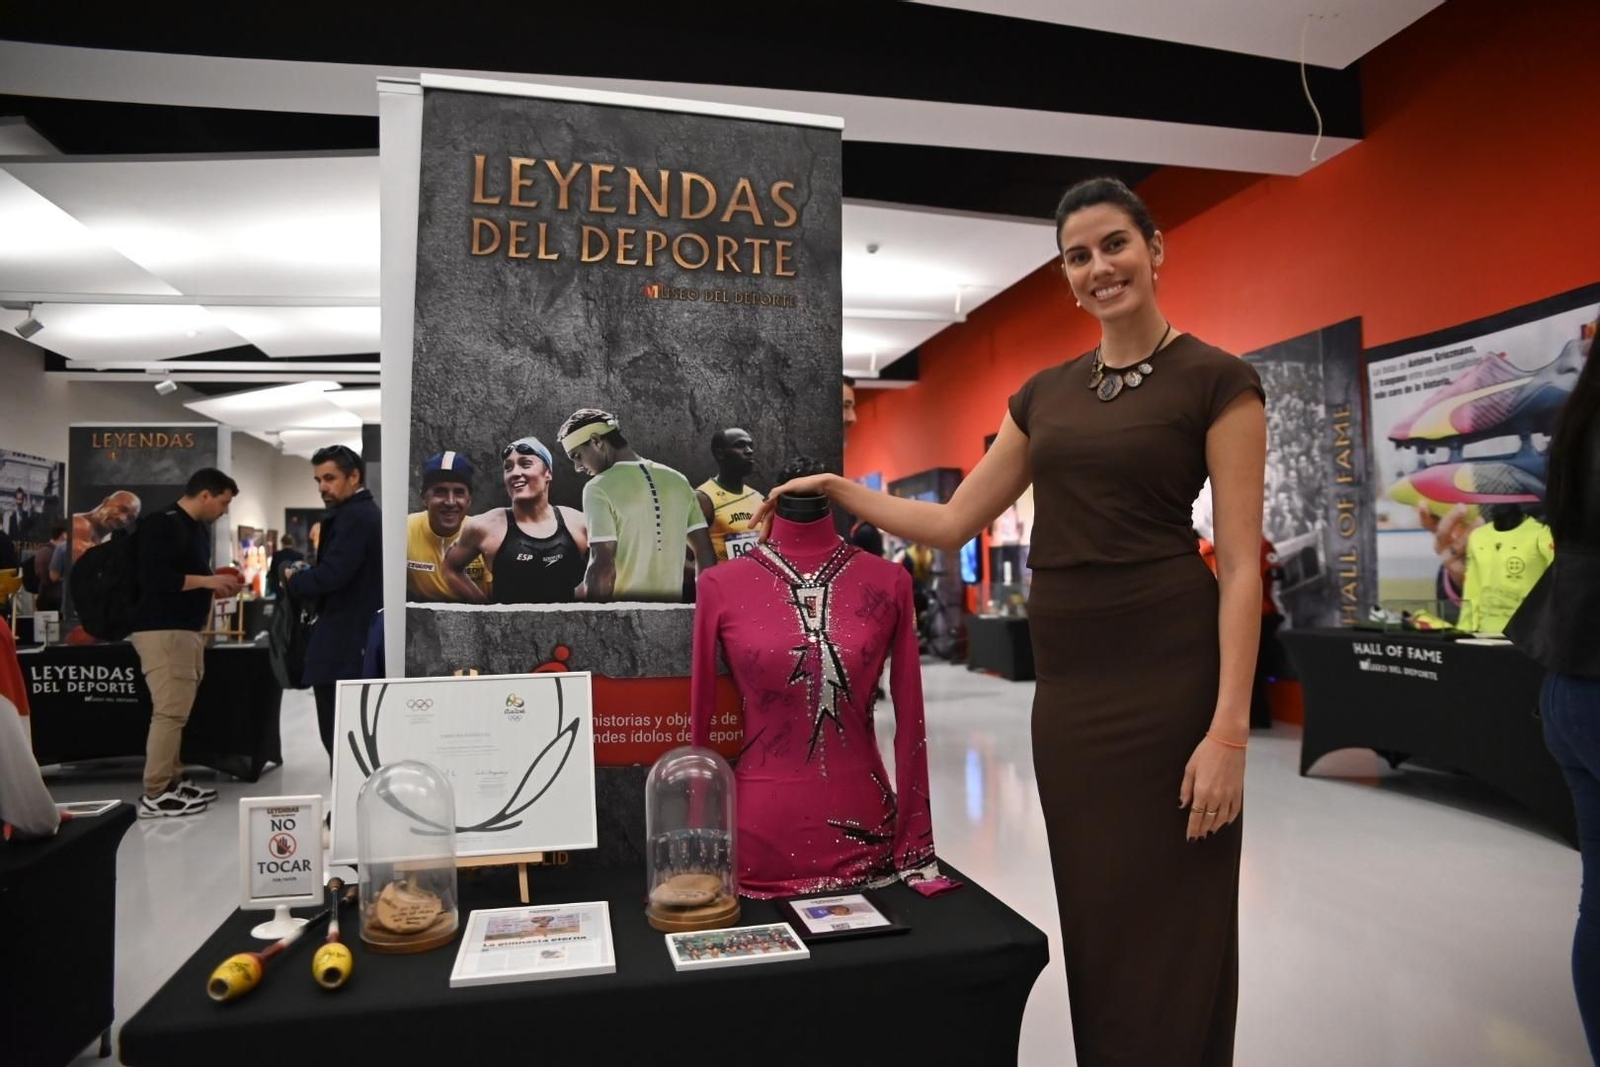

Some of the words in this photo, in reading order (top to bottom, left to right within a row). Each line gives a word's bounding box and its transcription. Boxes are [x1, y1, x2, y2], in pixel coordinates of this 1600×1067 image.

[472, 153, 798, 229] LEYENDAS
[470, 217, 560, 261] DEL
[580, 224, 797, 277] DEPORTE
[643, 284, 699, 300] MUSEO
[705, 289, 729, 302] DEL
[734, 292, 797, 307] DEPORTE
[92, 433, 194, 448] LEYENDAS
[1333, 402, 1353, 483] FAME
[728, 512, 754, 525] JAMA
[1337, 495, 1357, 538] OF
[516, 553, 533, 561] ESP
[732, 542, 758, 557] BO
[1339, 546, 1359, 625] HALL
[1352, 642, 1383, 656] HALL
[1385, 645, 1403, 657] OF
[1406, 646, 1443, 664] FAME
[31, 666, 135, 681] LEYENDAS
[32, 682, 60, 694] DEL
[67, 681, 136, 694] DEPORTE
[654, 716, 663, 728] y
[721, 712, 737, 725] de
[592, 730, 626, 743] ndes
[631, 729, 673, 743] ídolos
[270, 818, 296, 831] NO
[257, 859, 312, 874] TOCAR
